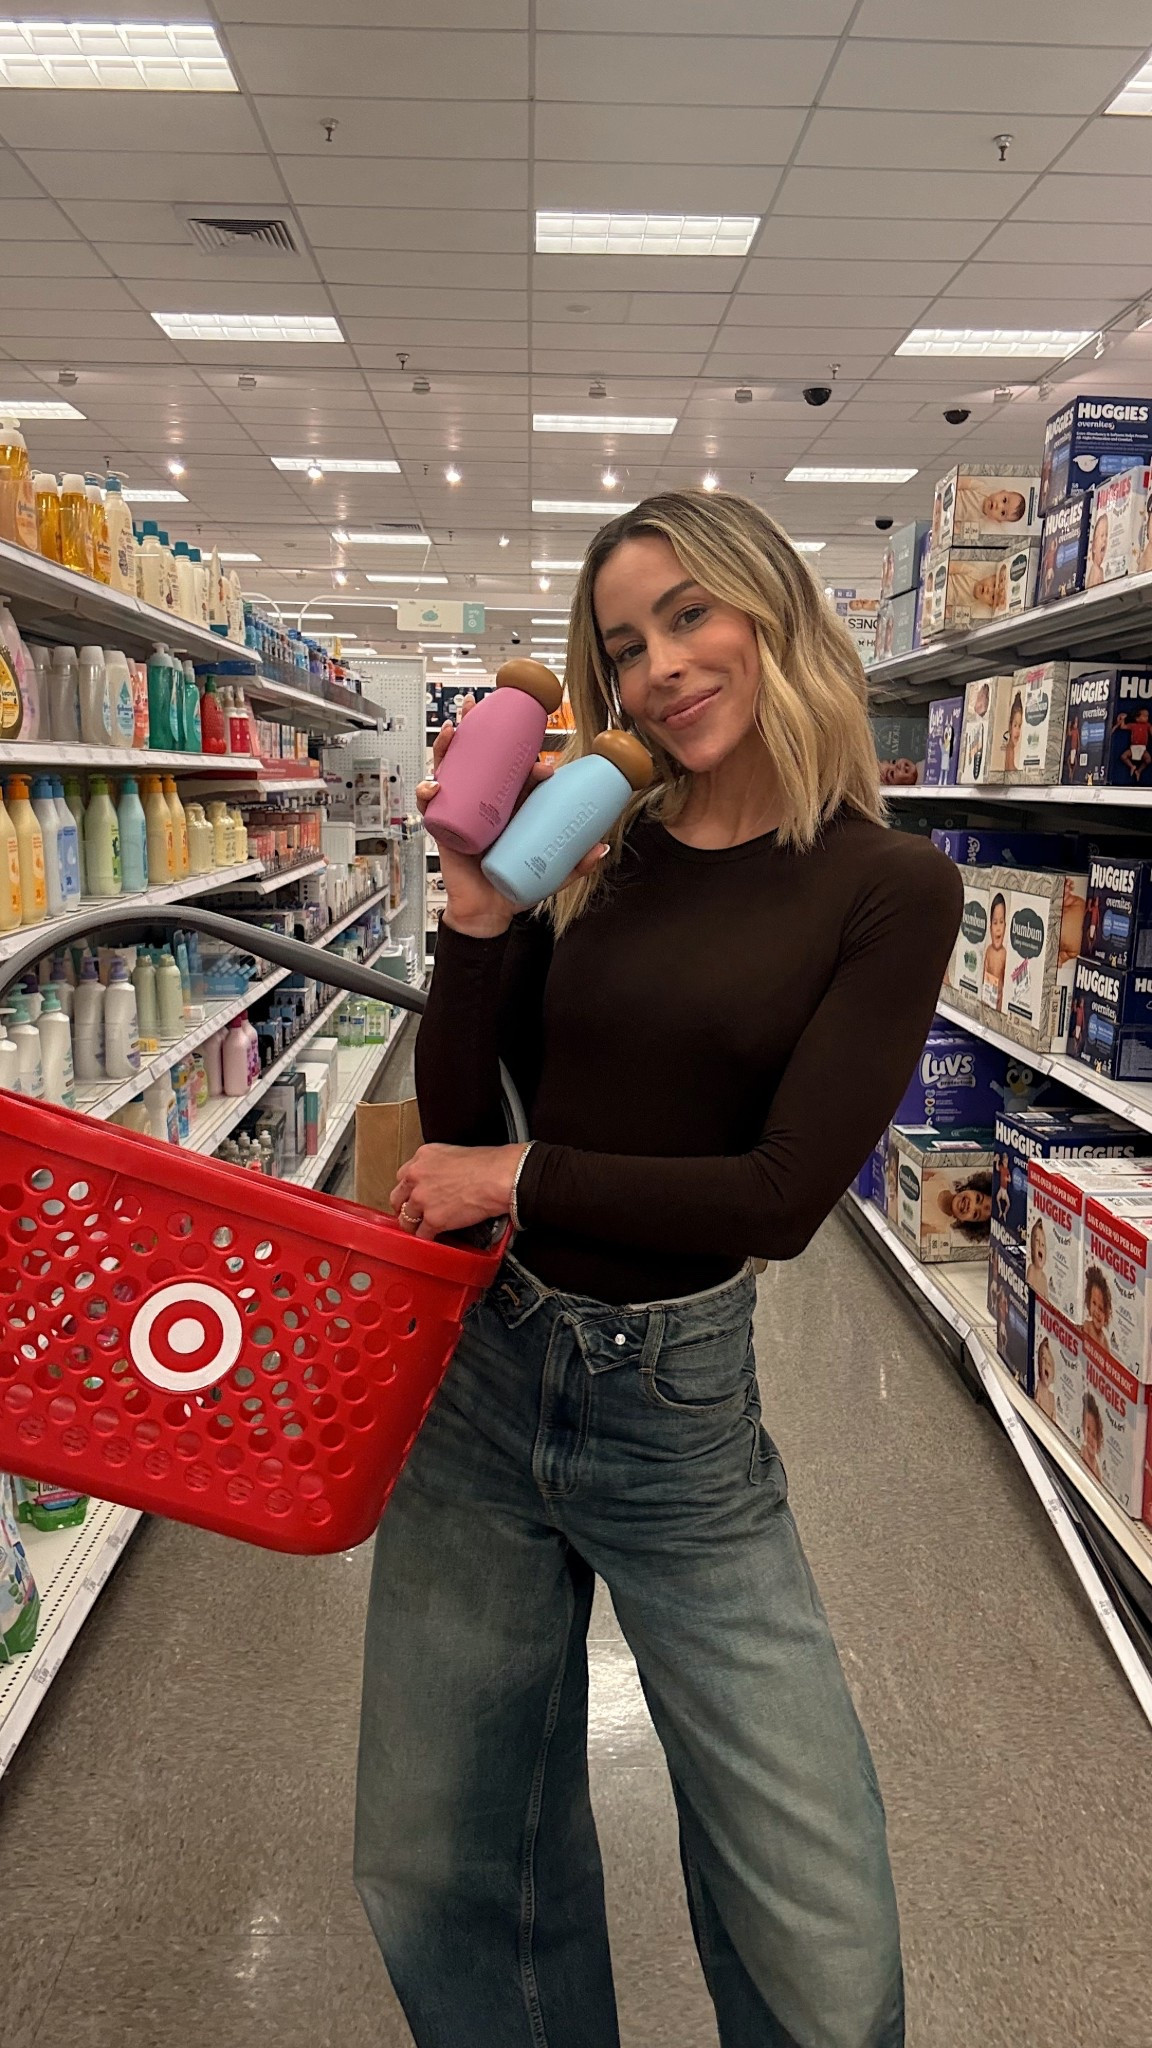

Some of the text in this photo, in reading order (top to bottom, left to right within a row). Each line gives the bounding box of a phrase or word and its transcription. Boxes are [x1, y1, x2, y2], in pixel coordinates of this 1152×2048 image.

[1077, 402, 1149, 421] HUGGIES
[1077, 420, 1112, 430] overnites
[1045, 500, 1084, 537] HUGGIES
[1070, 679, 1110, 706] HUGGIES
[1090, 863, 1135, 894] HUGGIES
[1012, 917, 1043, 943] bumbum
[1075, 964, 1120, 1003] HUGGIES
[921, 1052, 973, 1085] Luvs
[995, 1119, 1043, 1159] HUGGIES
[1050, 1145, 1135, 1159] HUGGIES
[1033, 1188, 1072, 1232] HUGGIES
[1098, 1221, 1113, 1239] OVER
[1119, 1234, 1130, 1251] PER
[1091, 1233, 1136, 1285] HUGGIES
[997, 1255, 1029, 1304] HUGGIES
[1040, 1306, 1079, 1358] HUGGIES
[1135, 1362, 1140, 1375] 7
[1086, 1360, 1127, 1418] HUGGIES
[1124, 1493, 1130, 1506] 7
